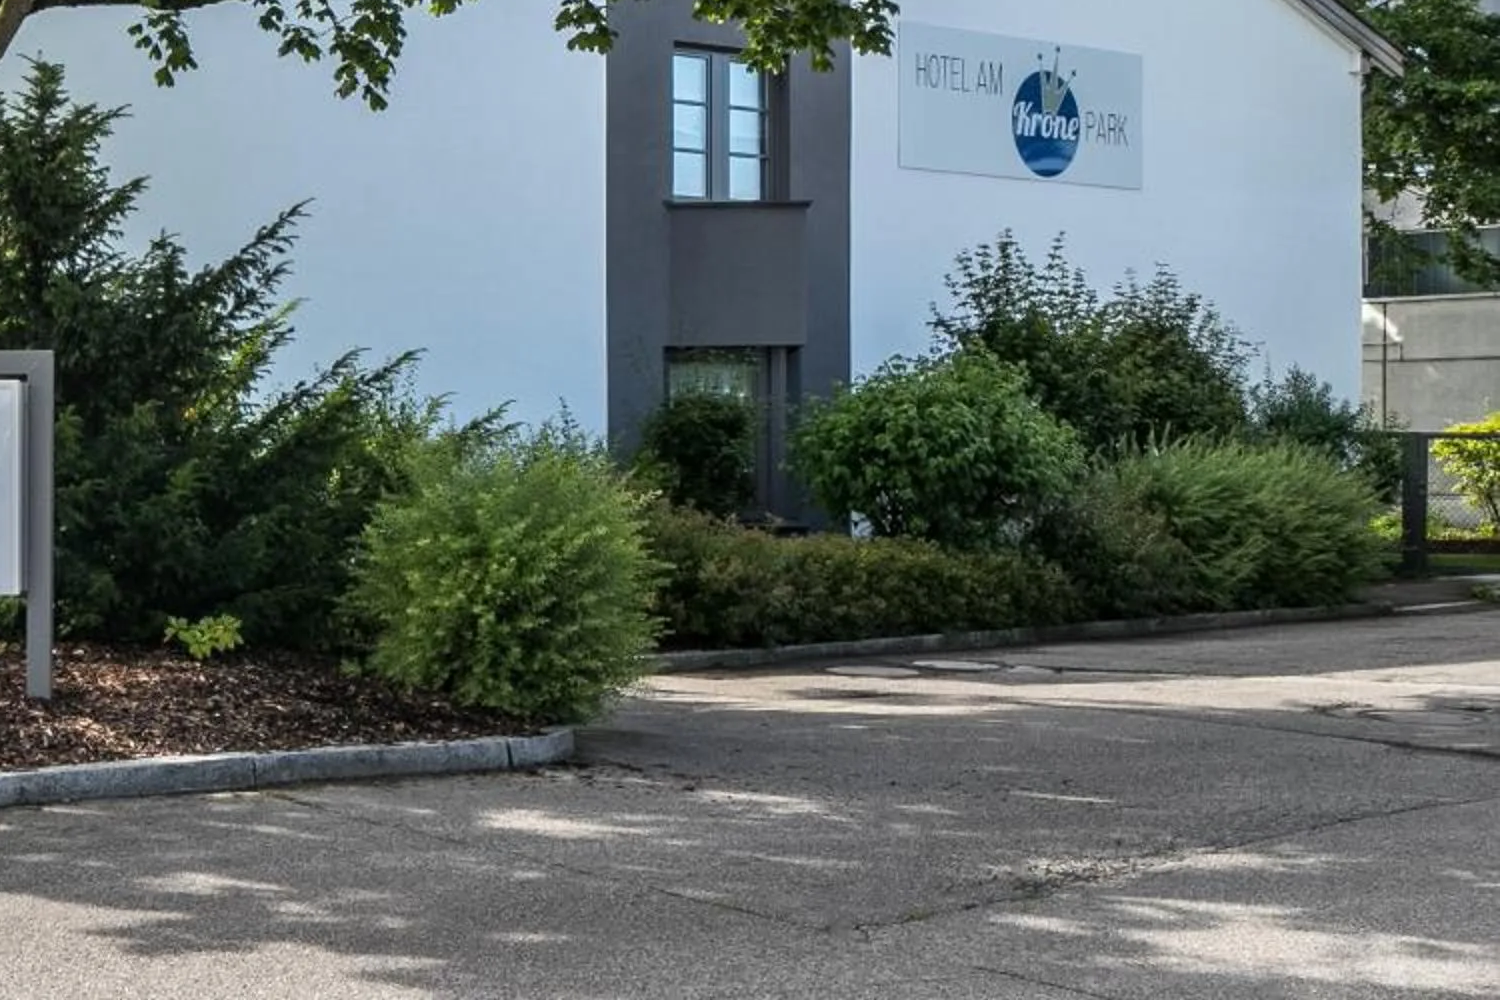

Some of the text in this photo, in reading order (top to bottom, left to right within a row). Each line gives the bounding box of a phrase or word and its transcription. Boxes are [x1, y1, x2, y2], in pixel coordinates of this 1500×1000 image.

[916, 54, 1003, 95] HOTEL AM
[1013, 100, 1129, 148] Krone PARK
